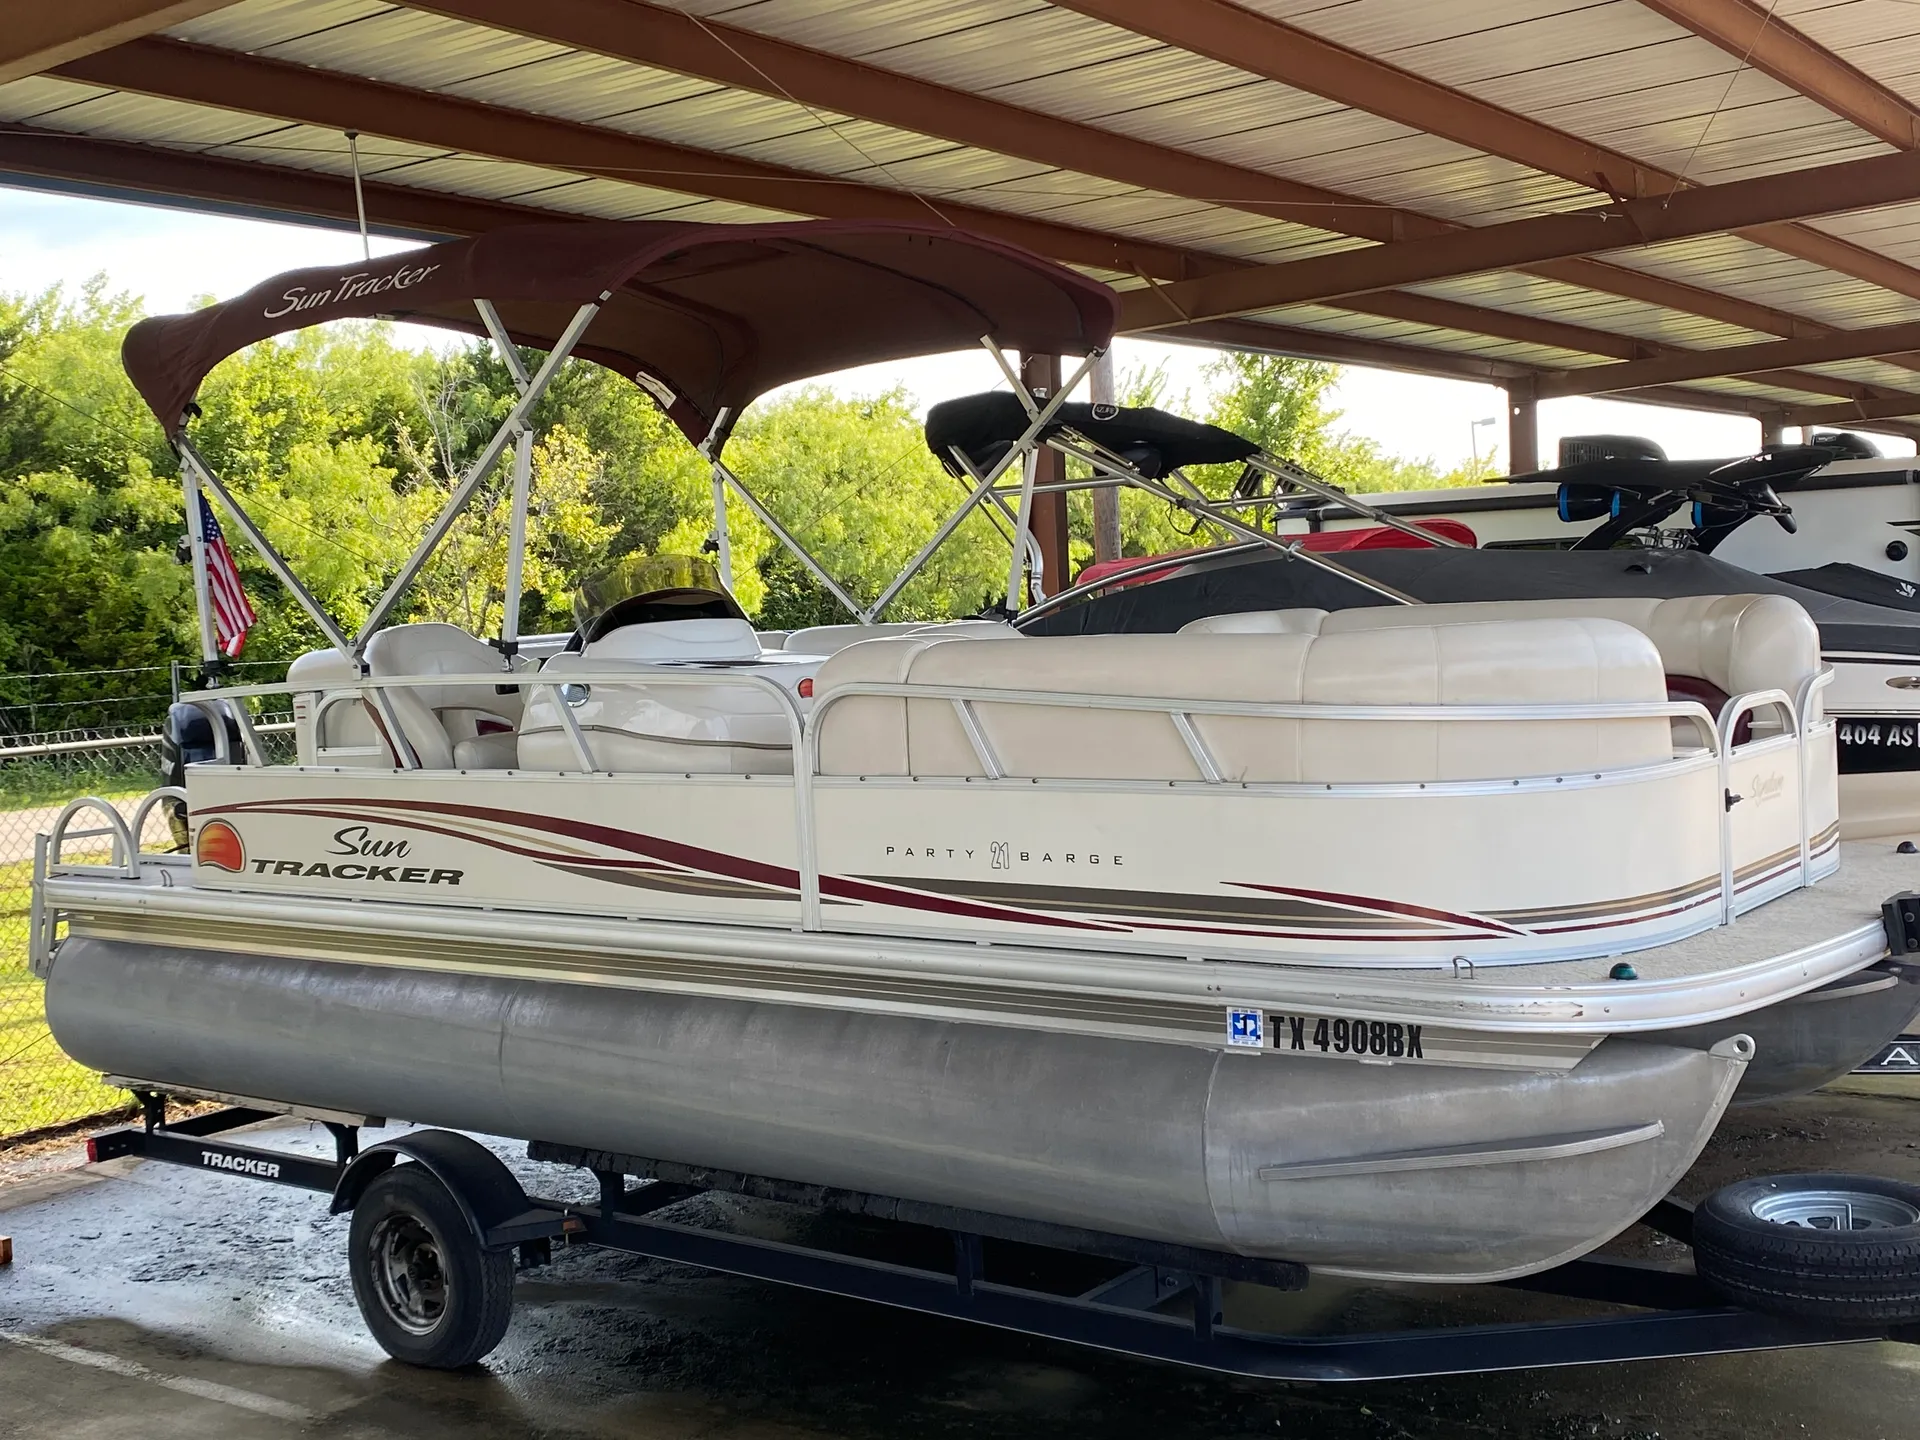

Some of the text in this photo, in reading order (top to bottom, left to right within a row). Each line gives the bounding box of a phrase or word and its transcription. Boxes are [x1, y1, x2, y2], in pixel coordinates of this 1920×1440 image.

[263, 264, 441, 319] Sun Tracker
[1839, 723, 1914, 747] 404 AS
[324, 826, 411, 858] Sun
[886, 841, 1123, 869] PARTY 21 BARGE
[250, 859, 464, 885] TRACKER
[1269, 1015, 1305, 1050] TX
[1313, 1018, 1423, 1059] 4908BX
[201, 1151, 280, 1178] TRACKER
